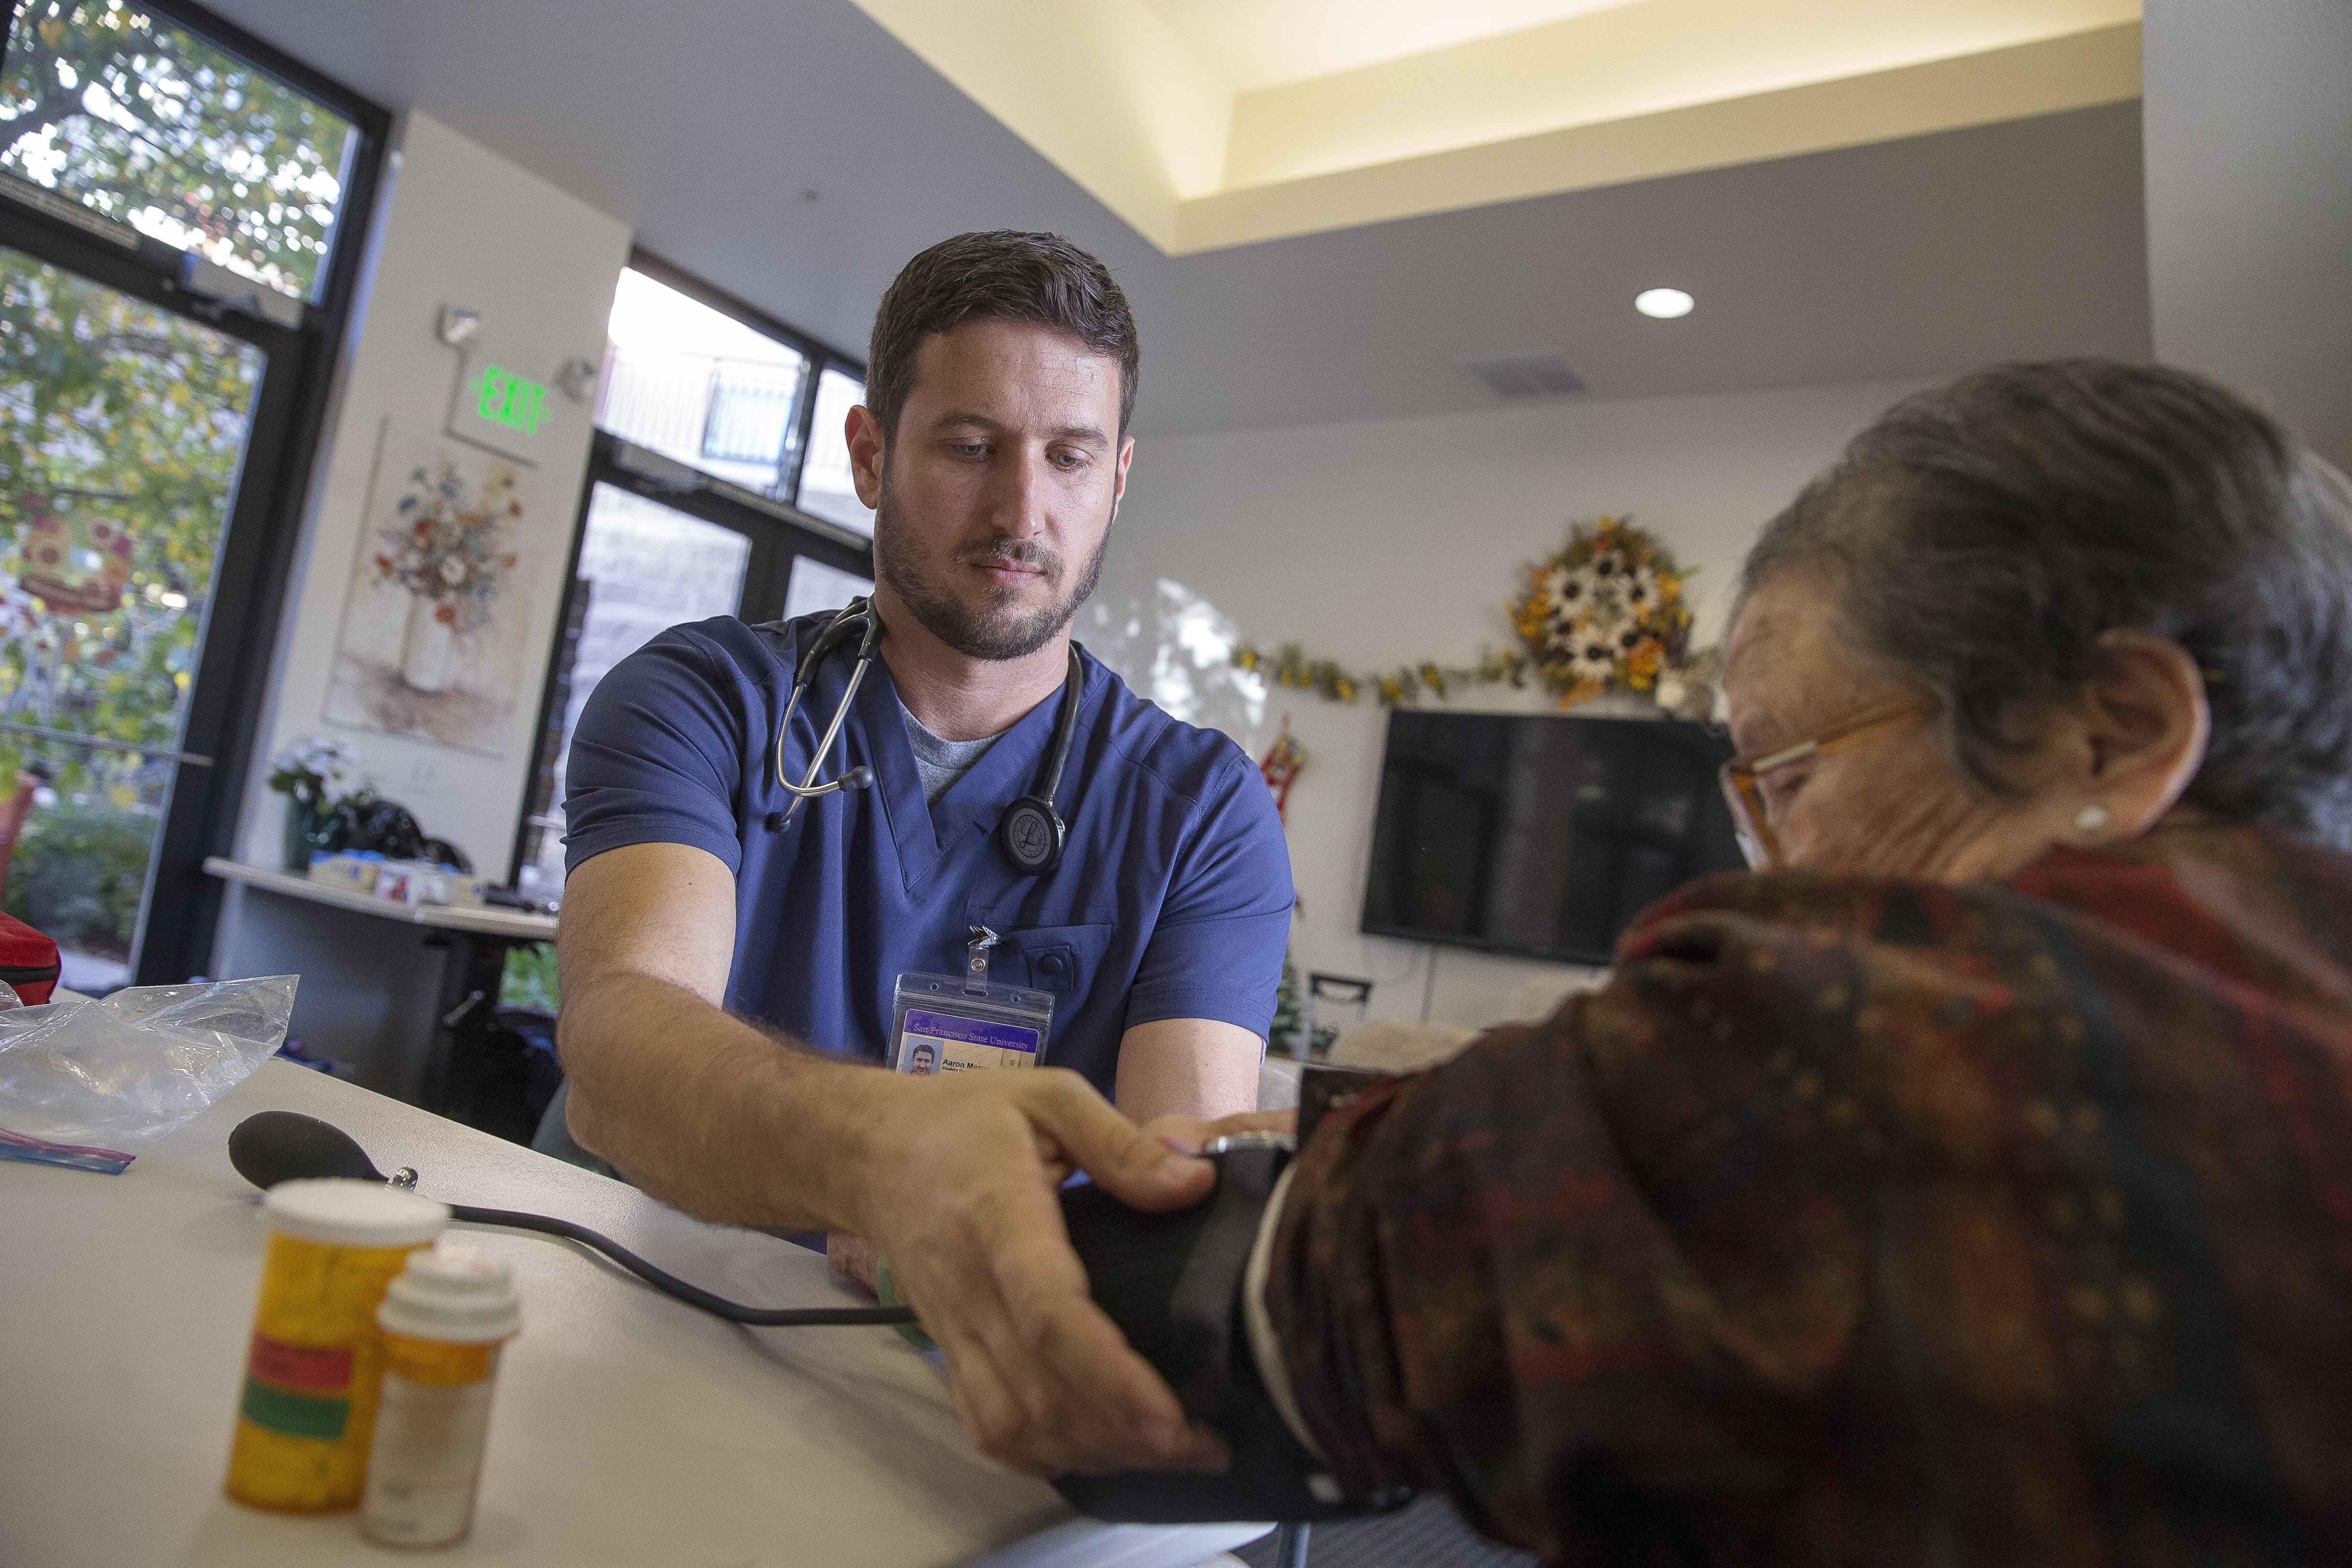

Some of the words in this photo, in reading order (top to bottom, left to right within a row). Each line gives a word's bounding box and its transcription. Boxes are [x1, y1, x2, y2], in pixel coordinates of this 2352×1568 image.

[477, 364, 548, 437] EXIT
[913, 1022, 928, 1033] San
[930, 1026, 967, 1040] Francisco
[968, 1033, 988, 1043] State
[990, 1036, 1029, 1051] University
[943, 1059, 965, 1068] Aaron
